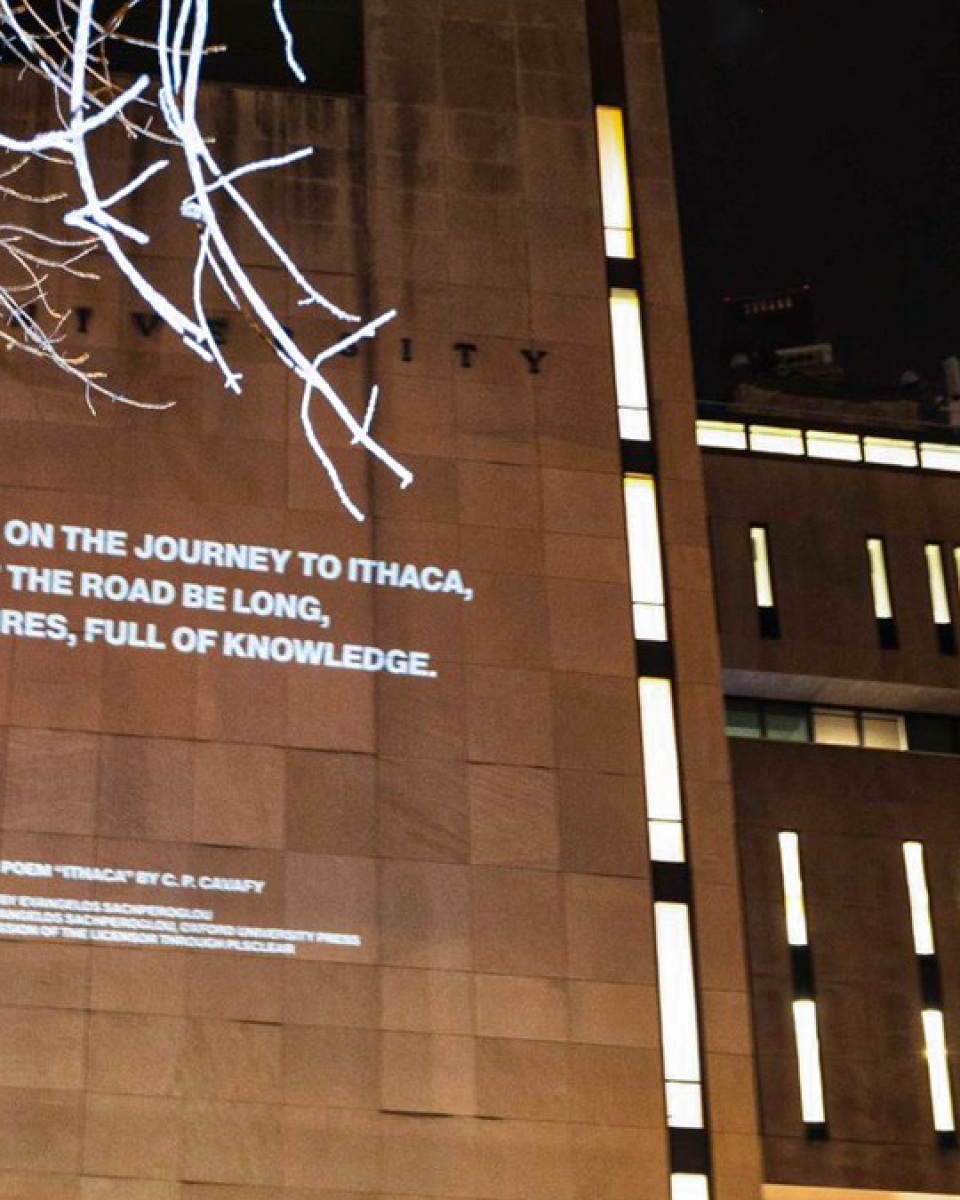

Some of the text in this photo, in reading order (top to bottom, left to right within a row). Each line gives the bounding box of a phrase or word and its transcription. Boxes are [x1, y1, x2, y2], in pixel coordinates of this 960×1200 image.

[4, 520, 55, 549] ON
[61, 525, 128, 557] THE
[134, 534, 292, 575] JOURNEY
[297, 551, 342, 581] TO
[347, 557, 474, 601] ITHACA,
[6, 563, 74, 596] THE
[80, 572, 176, 606] ROAD
[182, 582, 228, 613] BE
[231, 588, 332, 629] LONG,
[83, 617, 167, 651] FULL
[171, 625, 219, 654] OF
[222, 631, 438, 679] KNOWLEDGE.
